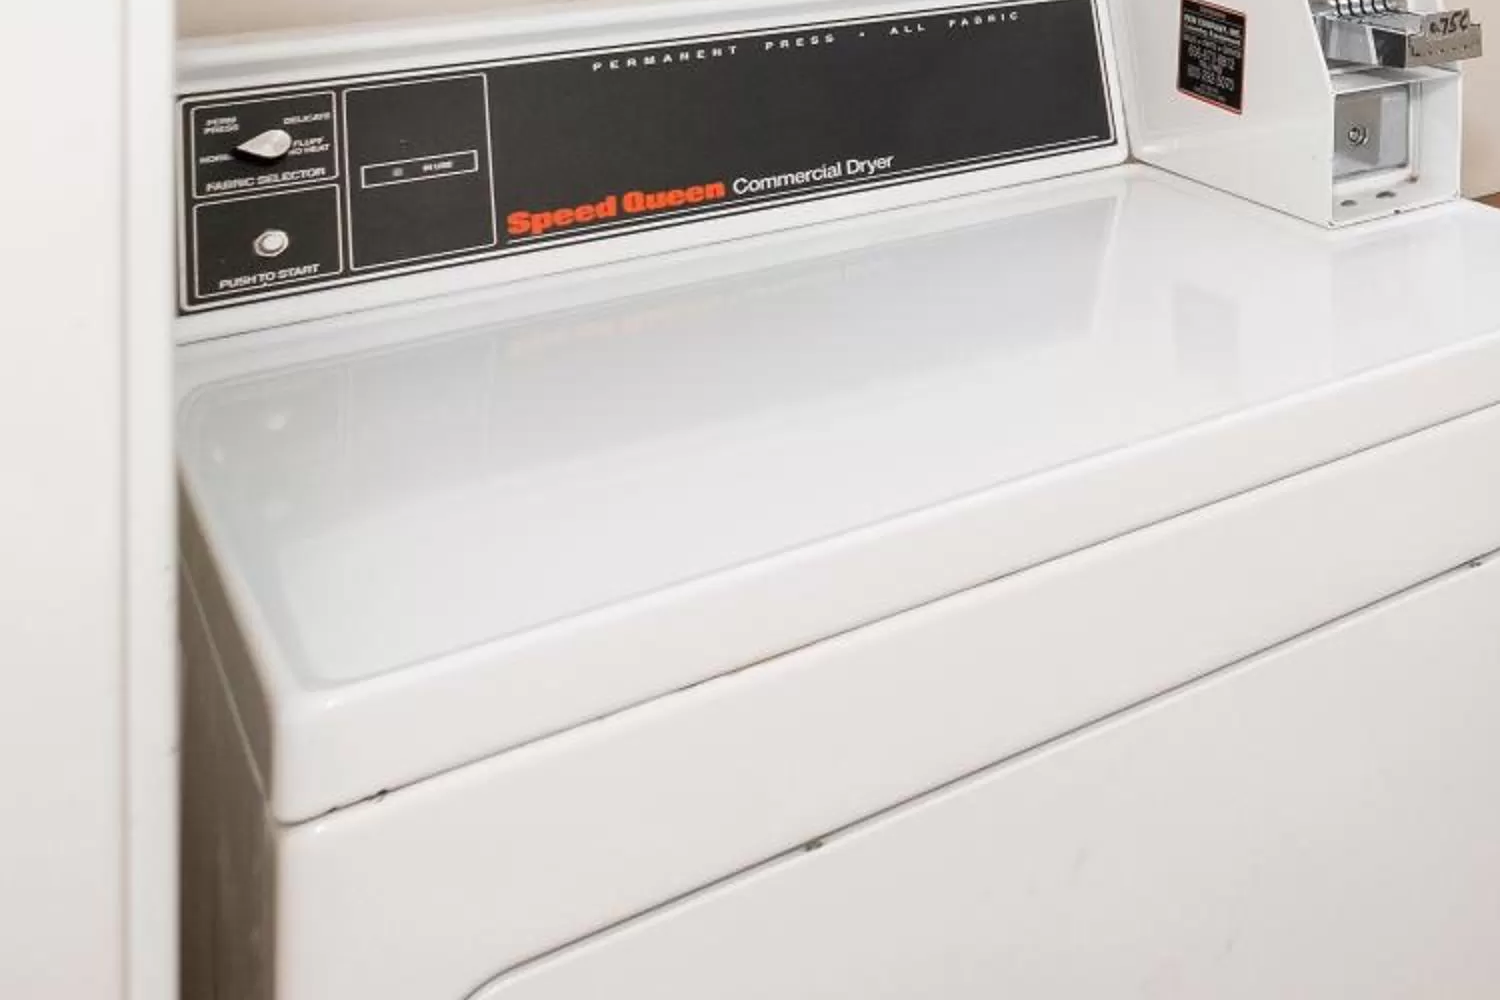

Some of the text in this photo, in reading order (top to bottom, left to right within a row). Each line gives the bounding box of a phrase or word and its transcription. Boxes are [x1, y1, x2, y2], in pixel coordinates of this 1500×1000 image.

[592, 10, 1021, 72] PERMANENT PRESS ALL FABRIC
[206, 167, 326, 192] FABRIC SELECTOR
[507, 154, 894, 238] Speed Queen Commercial Dryer
[219, 263, 321, 289] PUSH TO START
